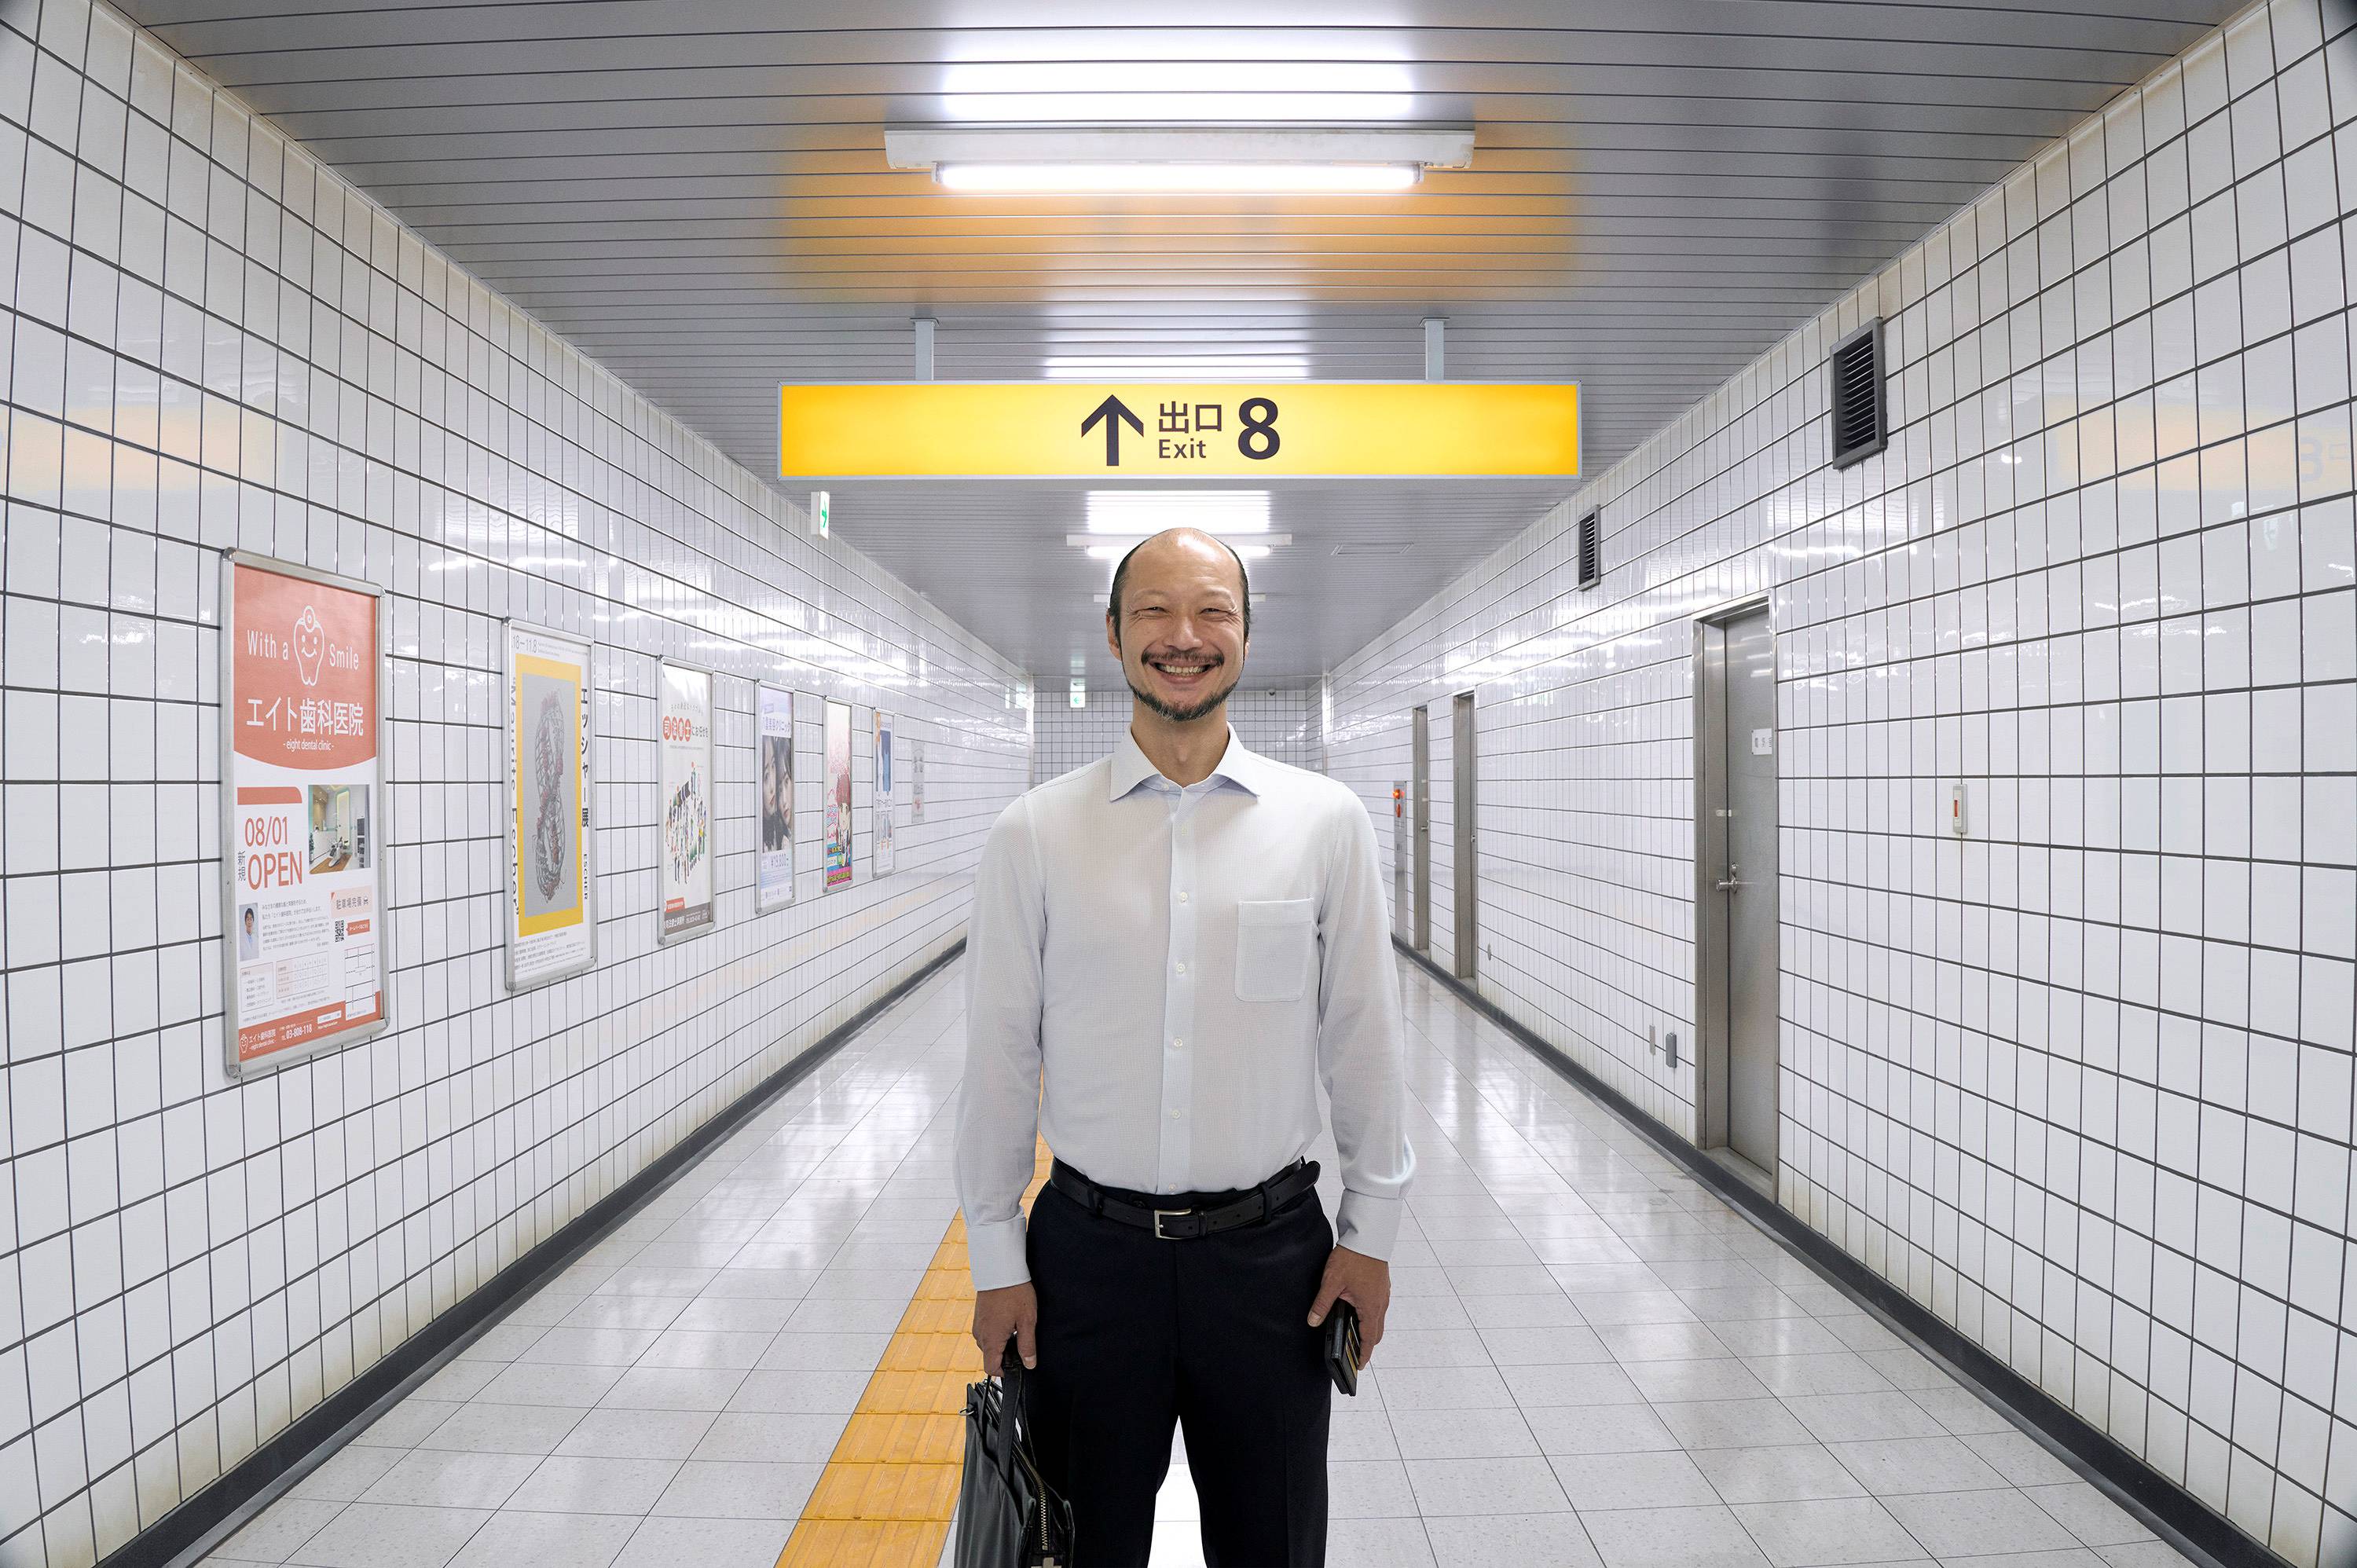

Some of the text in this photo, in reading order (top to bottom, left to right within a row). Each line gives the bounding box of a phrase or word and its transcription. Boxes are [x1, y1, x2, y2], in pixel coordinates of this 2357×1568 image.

[1159, 401, 1222, 434] 出口
[1238, 397, 1281, 460] 8
[1159, 438, 1207, 459] Exit
[247, 629, 359, 670] With a Smile
[247, 697, 364, 736] エイト歯科医院
[581, 688, 589, 827] エッシャー展
[244, 815, 288, 848] 08/01
[238, 850, 246, 881] 新規
[247, 851, 303, 891] OPEN
